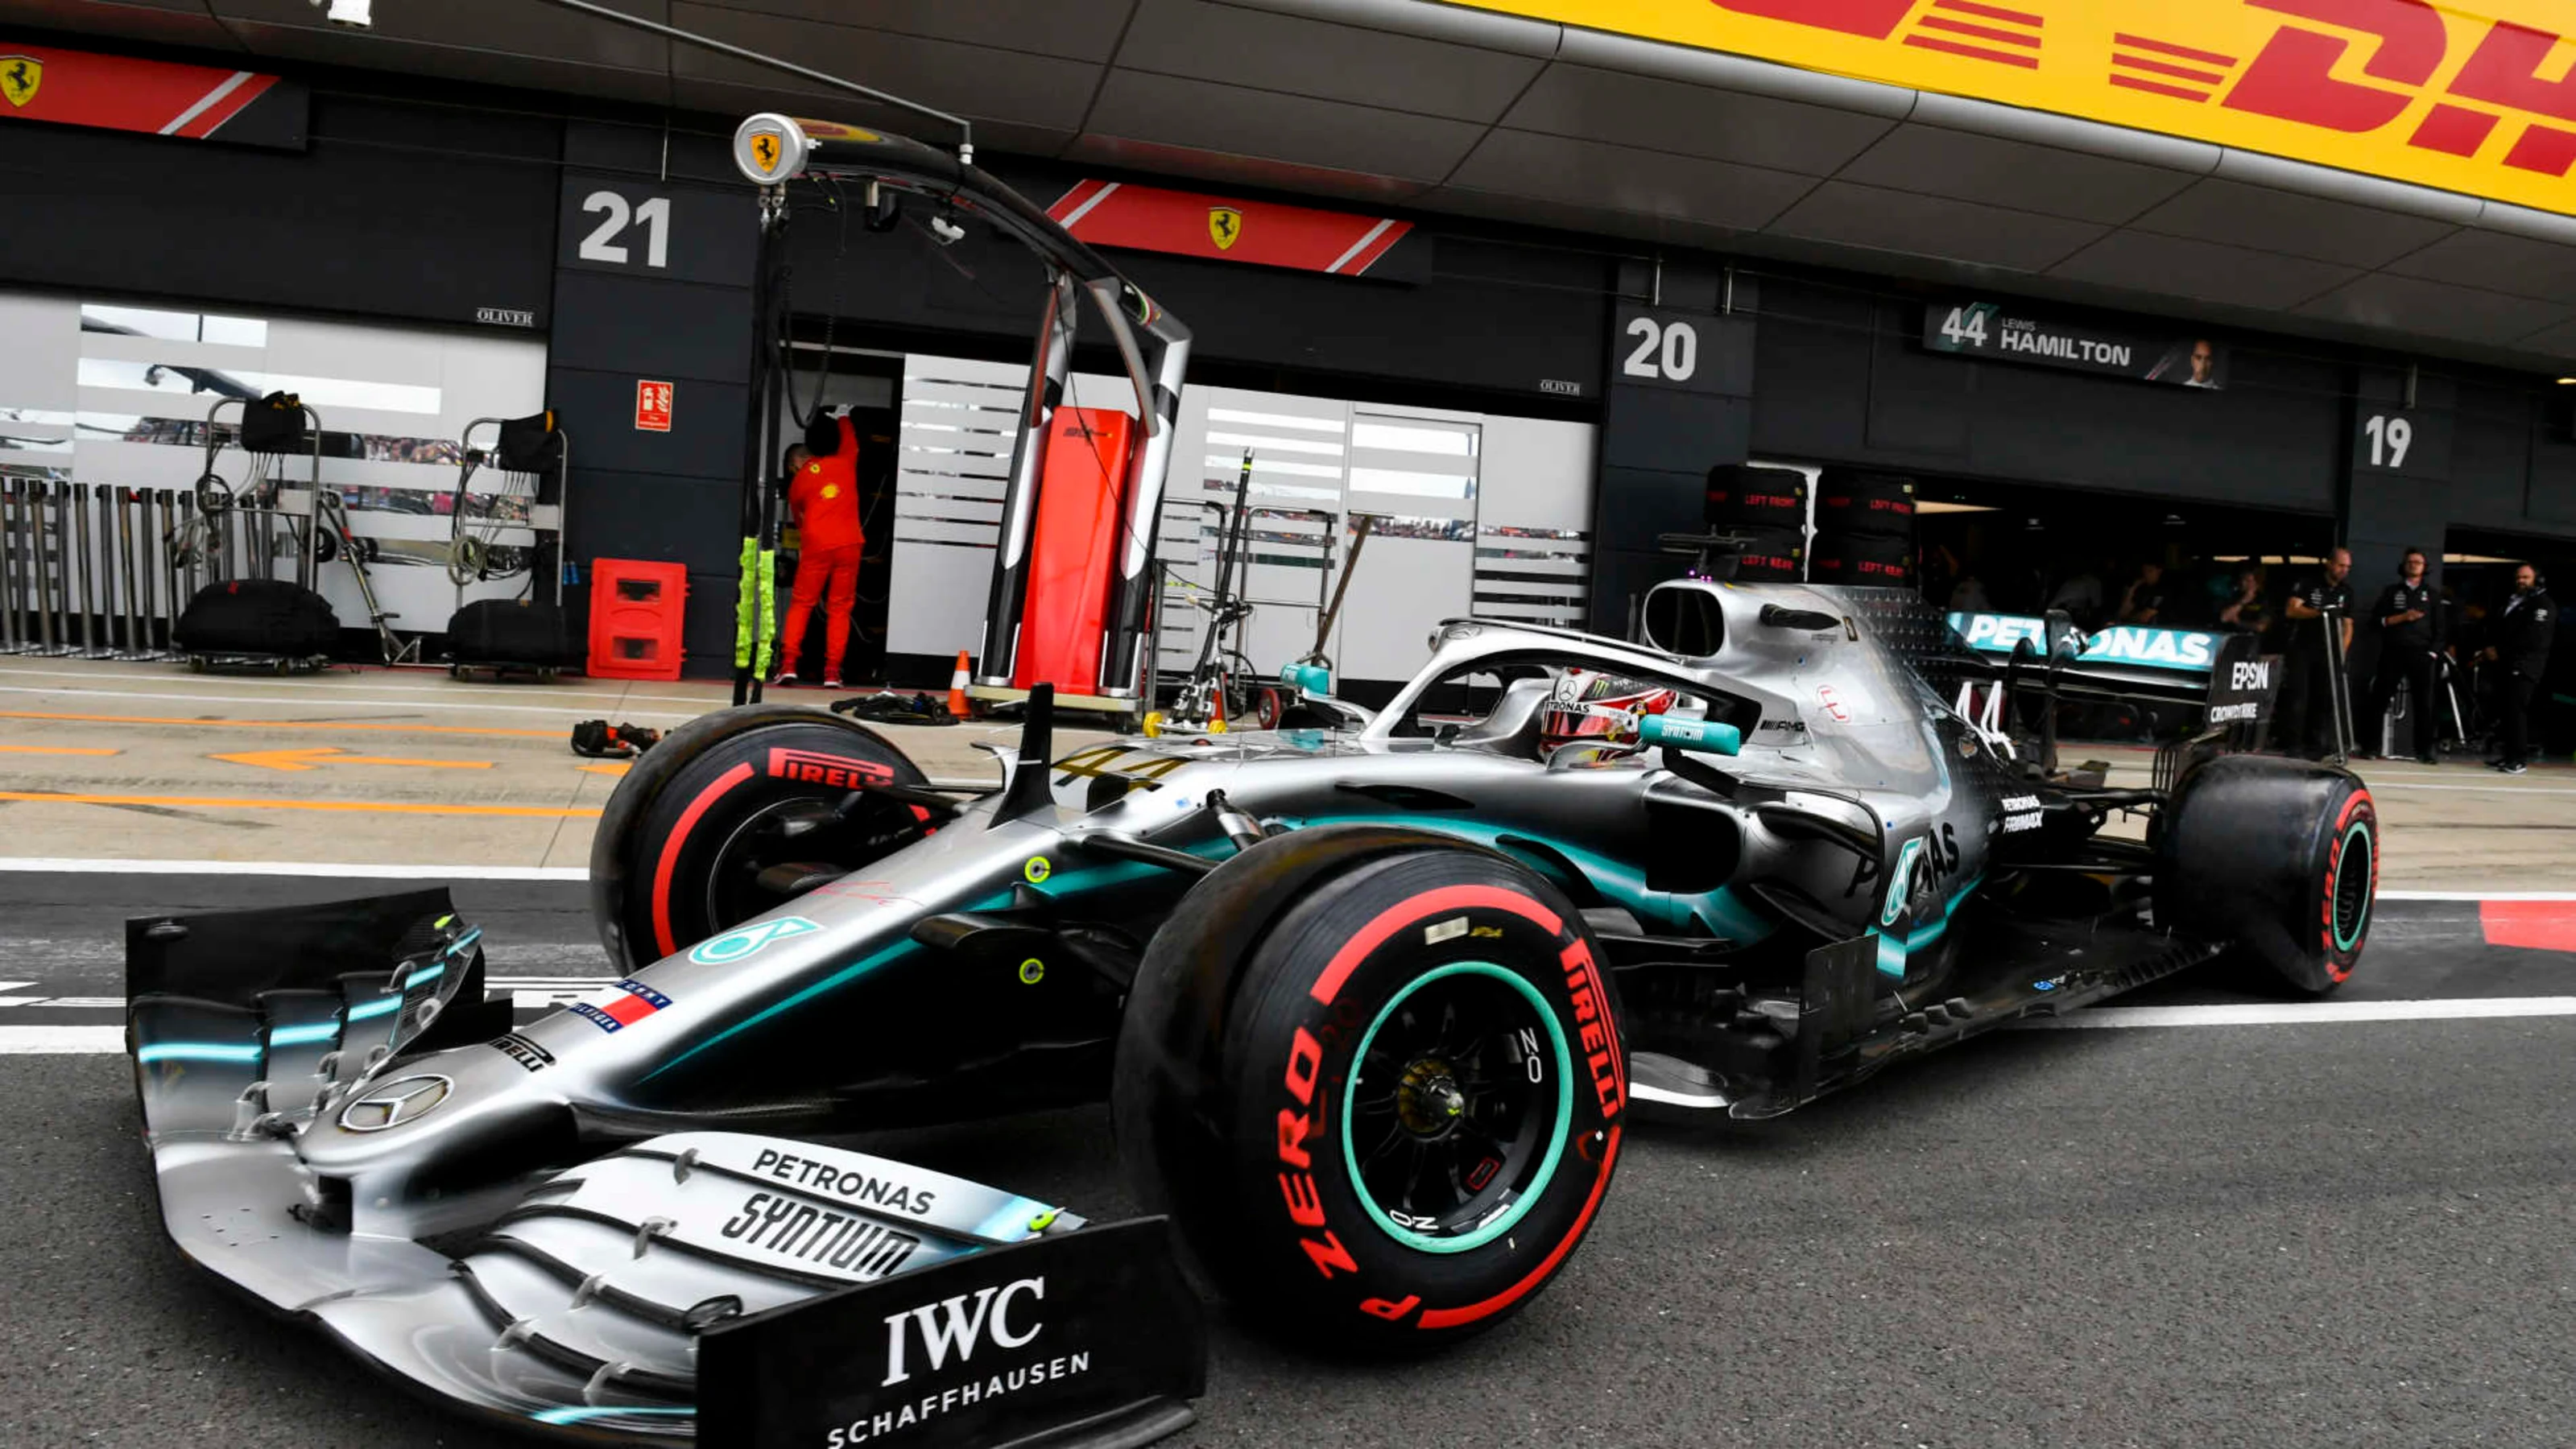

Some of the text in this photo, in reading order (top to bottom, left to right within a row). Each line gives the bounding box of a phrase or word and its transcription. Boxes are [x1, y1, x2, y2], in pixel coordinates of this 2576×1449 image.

[579, 190, 670, 268] 21
[477, 308, 535, 327] OLIVER
[1623, 317, 1697, 382] 20
[1941, 308, 1987, 347] 44
[2000, 328, 2131, 367] HAMILTON
[2002, 318, 2036, 332] LEWIS
[2366, 415, 2412, 468] 19
[488, 1032, 556, 1073] PIRELLI
[1559, 937, 1627, 1119] PIRELLI
[752, 1148, 936, 1216] PETRONAS
[1277, 1025, 1359, 1279] ZERO
[720, 1192, 921, 1277] SYNTIUM
[881, 1276, 1045, 1387] IWC
[827, 1351, 1090, 1449] SCHAFFHAUSEN
